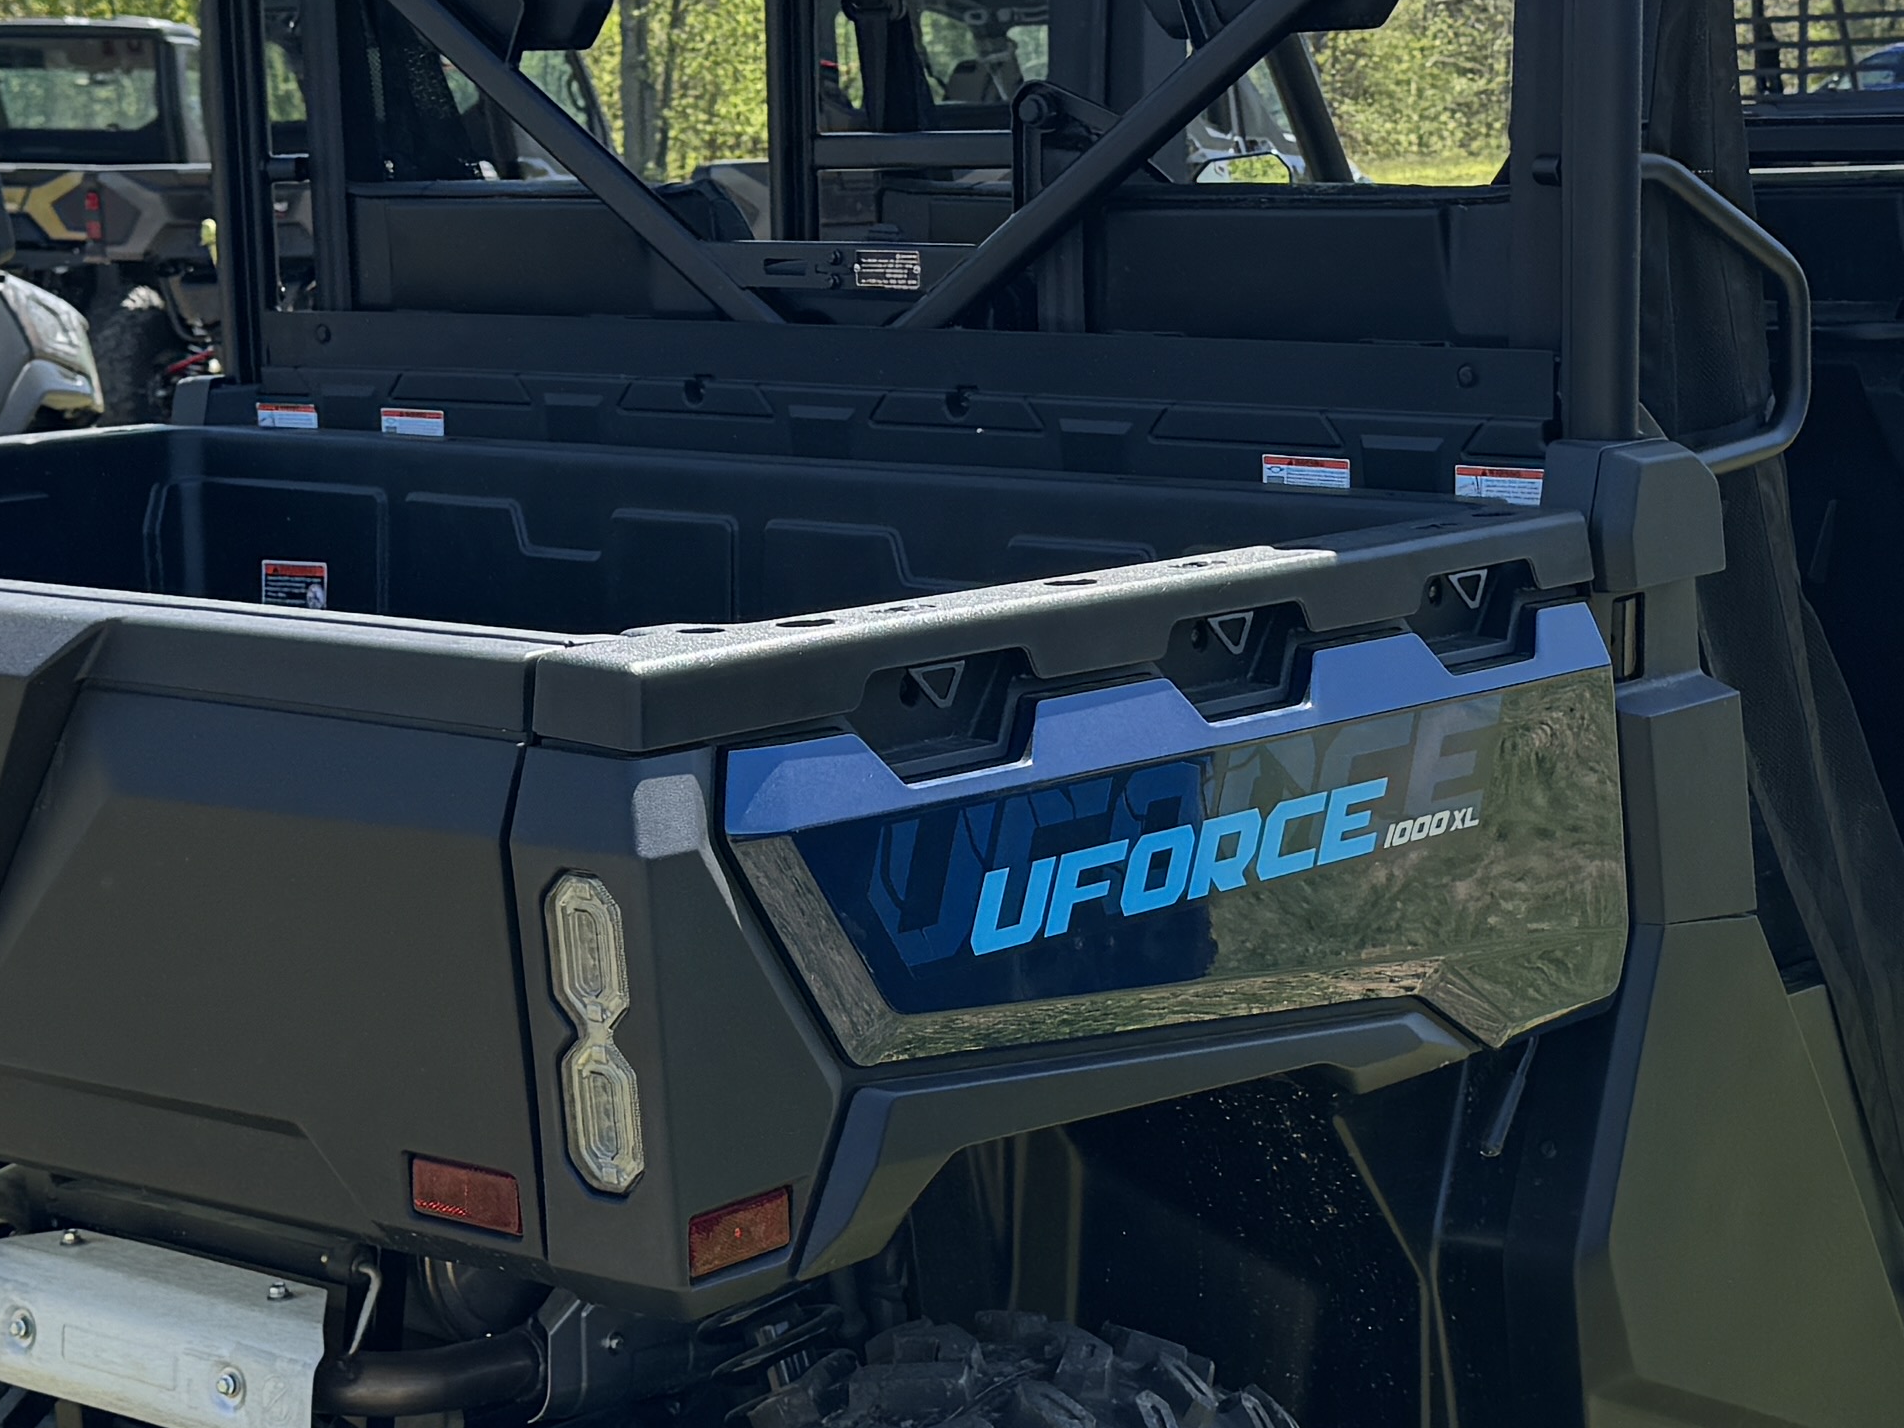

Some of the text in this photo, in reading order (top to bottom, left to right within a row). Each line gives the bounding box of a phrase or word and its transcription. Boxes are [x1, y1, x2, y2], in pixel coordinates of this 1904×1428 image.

[970, 776, 1480, 957] UFORCE 1000 XL
